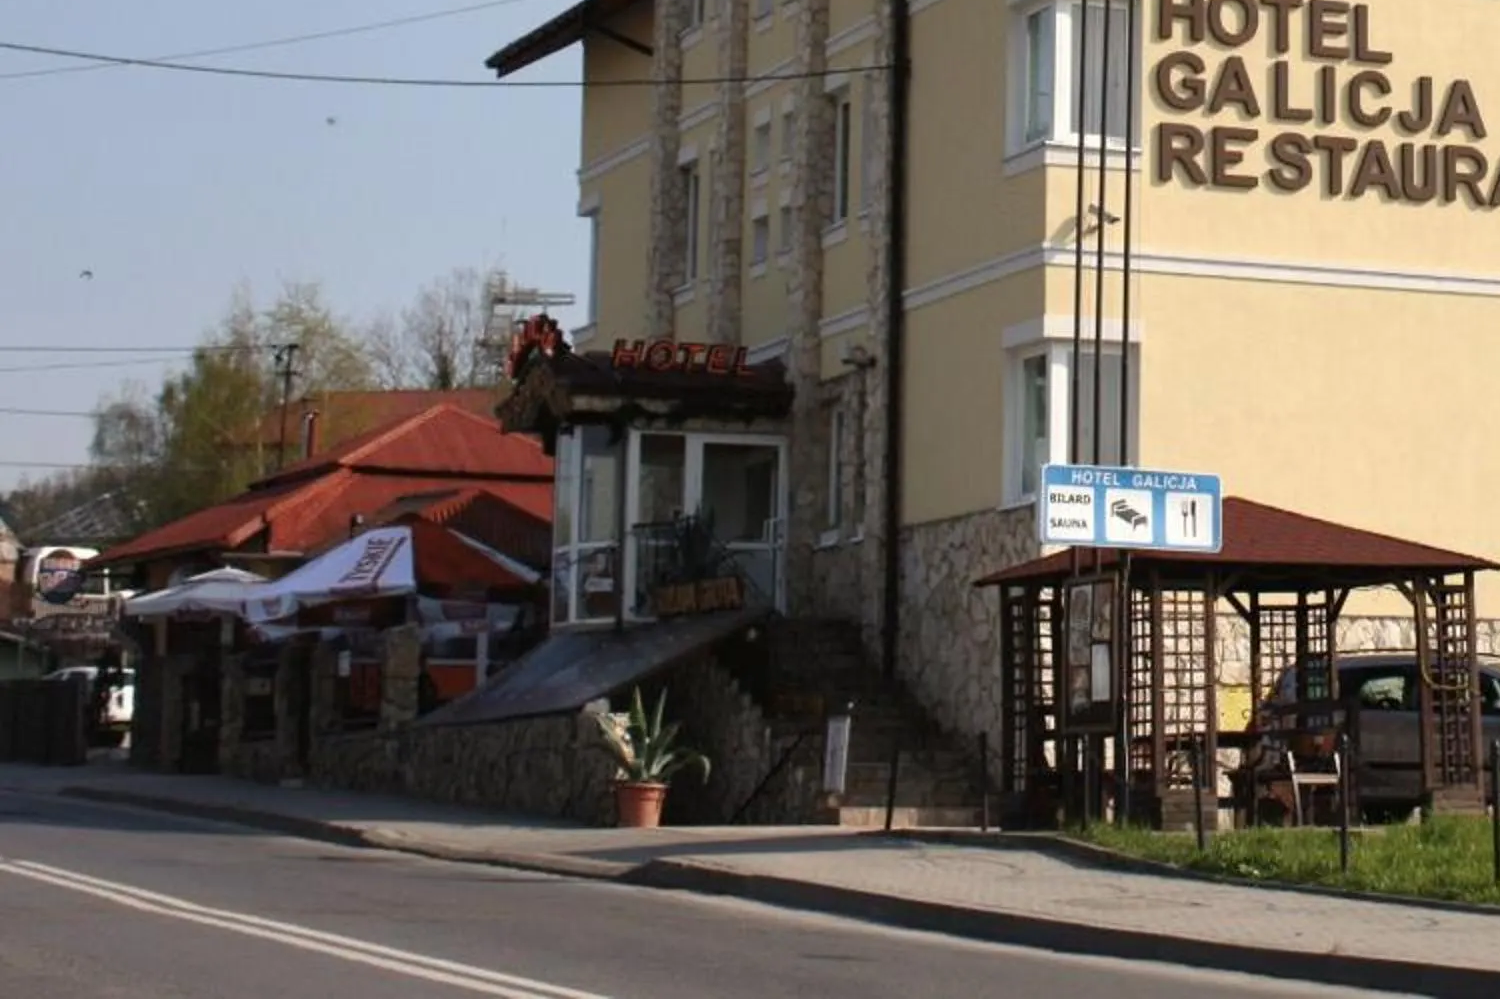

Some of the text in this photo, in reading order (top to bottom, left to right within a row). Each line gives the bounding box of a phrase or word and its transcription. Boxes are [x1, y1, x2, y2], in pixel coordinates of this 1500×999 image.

[1154, 52, 1487, 138] GALICJA
[612, 338, 758, 377] HOTEL
[1071, 470, 1198, 490] HOTEL GALICJA
[1049, 493, 1091, 505] BILARD
[1049, 518, 1088, 529] SAUNA
